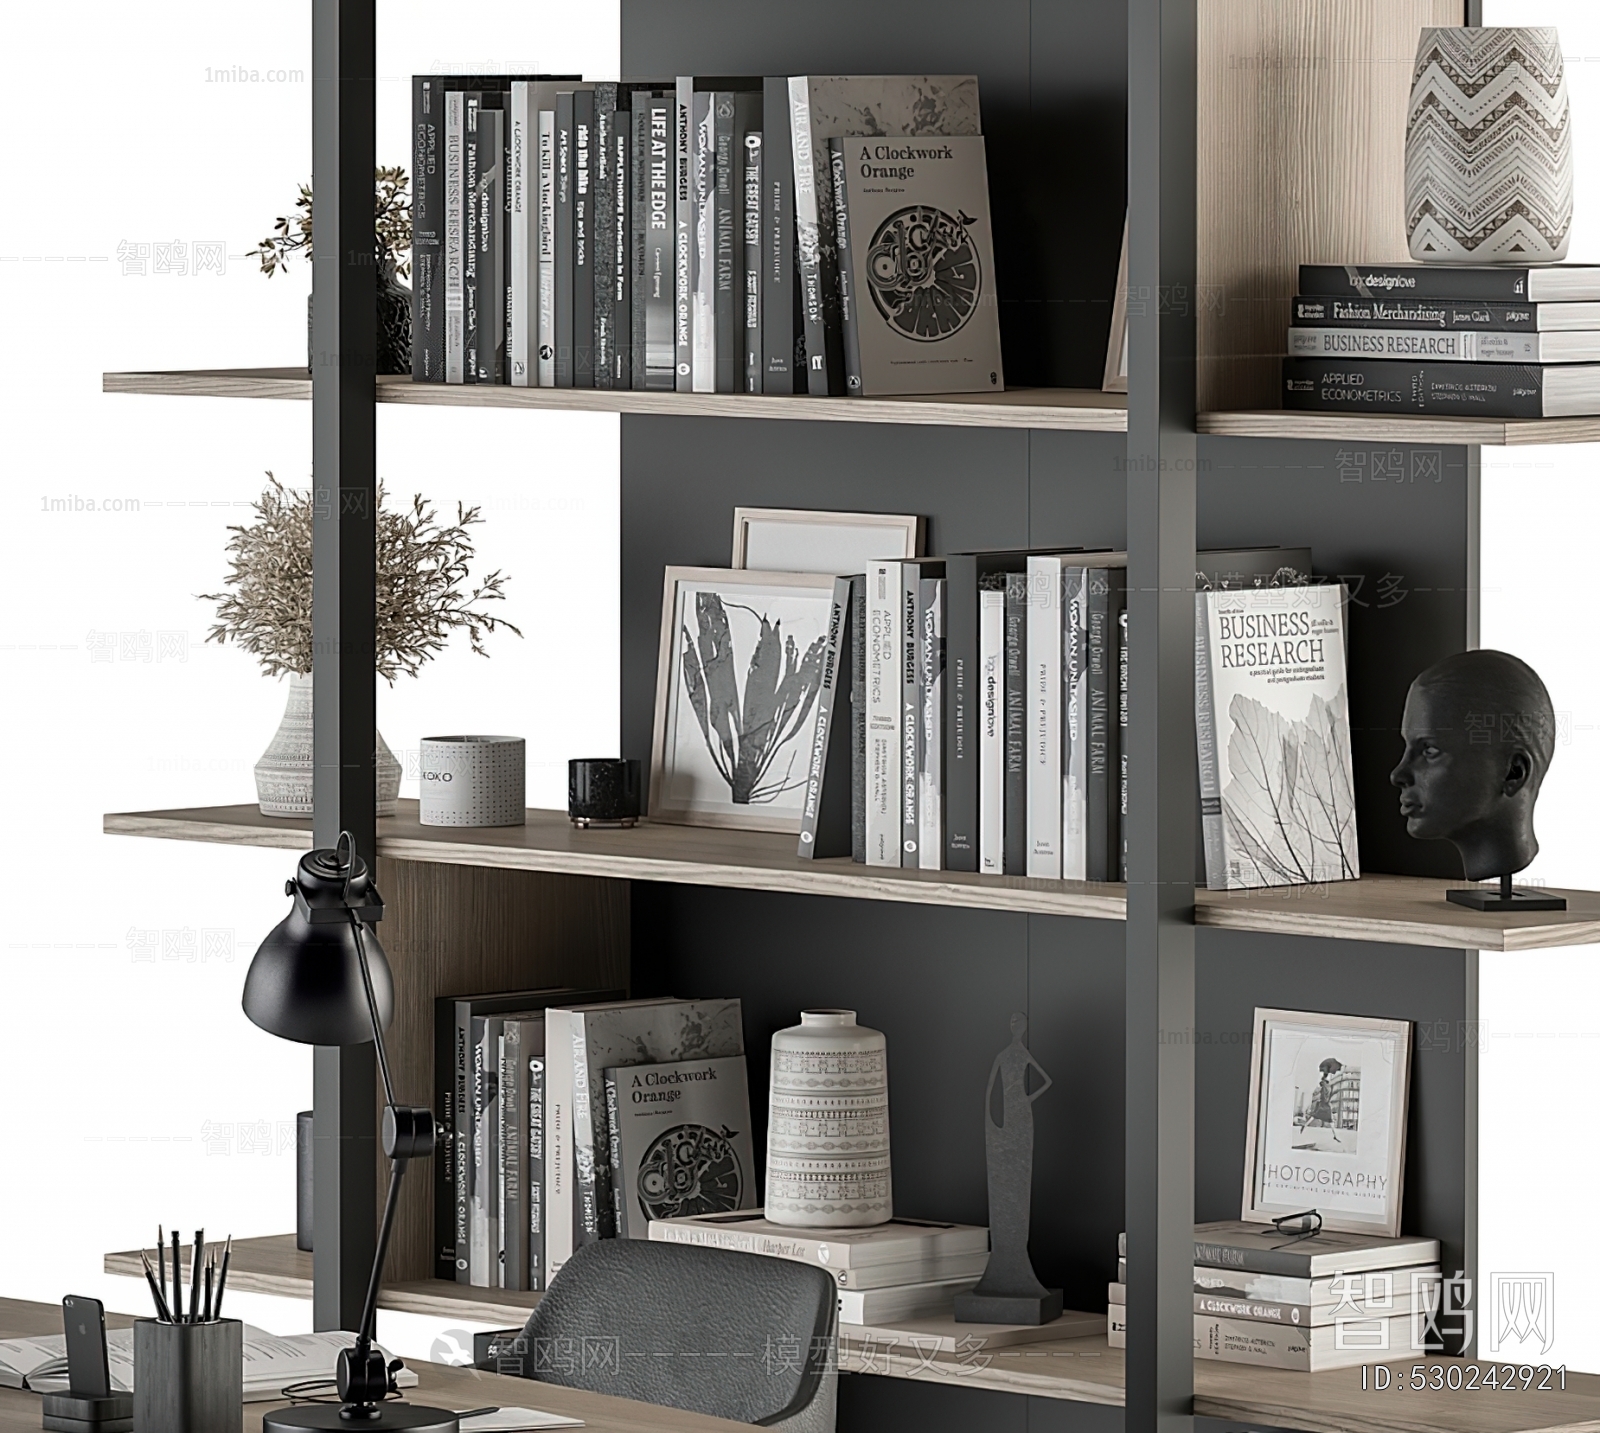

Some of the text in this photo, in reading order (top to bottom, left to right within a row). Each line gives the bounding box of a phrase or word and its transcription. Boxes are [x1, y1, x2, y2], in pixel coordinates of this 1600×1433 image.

[651, 108, 667, 137] LIFE
[427, 124, 437, 175] APPLIED
[542, 132, 551, 147] To
[651, 140, 667, 158] AT
[698, 121, 708, 178] WOMAN
[793, 100, 814, 194] AIR AND FIRE
[831, 150, 843, 159] A
[860, 145, 953, 161] A Clockwork
[448, 135, 461, 205] BUSINESS
[542, 149, 551, 170] Kill
[651, 160, 667, 189] THE
[746, 165, 759, 181] THE
[860, 163, 915, 180] Orange
[541, 182, 551, 255] Mockingbird
[651, 191, 667, 229] EDGE
[678, 104, 688, 347] ANTHONY BURGESS A CLOCKWORK ORANGE
[719, 207, 732, 255] ANIMAL
[719, 258, 732, 291] FARM
[1323, 334, 1384, 353] BUSINESS
[1387, 336, 1456, 355] RESEARCH
[1321, 373, 1365, 385] APPLIED
[1321, 389, 1402, 402] ECONOMETRICS
[830, 602, 843, 647] ANTHONY
[883, 610, 892, 661] APPLIED
[925, 608, 935, 662] WOMAN
[1070, 599, 1079, 656] WOMAN
[1219, 612, 1309, 640] BUSINESS
[872, 610, 882, 704] ECONOMETRICS
[1221, 639, 1325, 669] RESEARCH
[819, 705, 829, 713] A
[905, 590, 915, 826] ANTHONY BURGESS A CLOCKWORK ORANGE
[1009, 689, 1024, 736] ANIMAL
[1091, 689, 1107, 737] ANIMAL
[809, 716, 827, 777] CLOCKWORK
[1008, 741, 1022, 773] FARM
[1091, 741, 1106, 774] FARM
[804, 779, 819, 819] ORANGE
[458, 1027, 466, 1071] ANTHONY
[573, 1034, 590, 1120] AIR AND FIRE
[631, 1066, 718, 1088] A Clockwork
[631, 1088, 682, 1105] Orange
[1200, 1299, 1206, 1310] A
